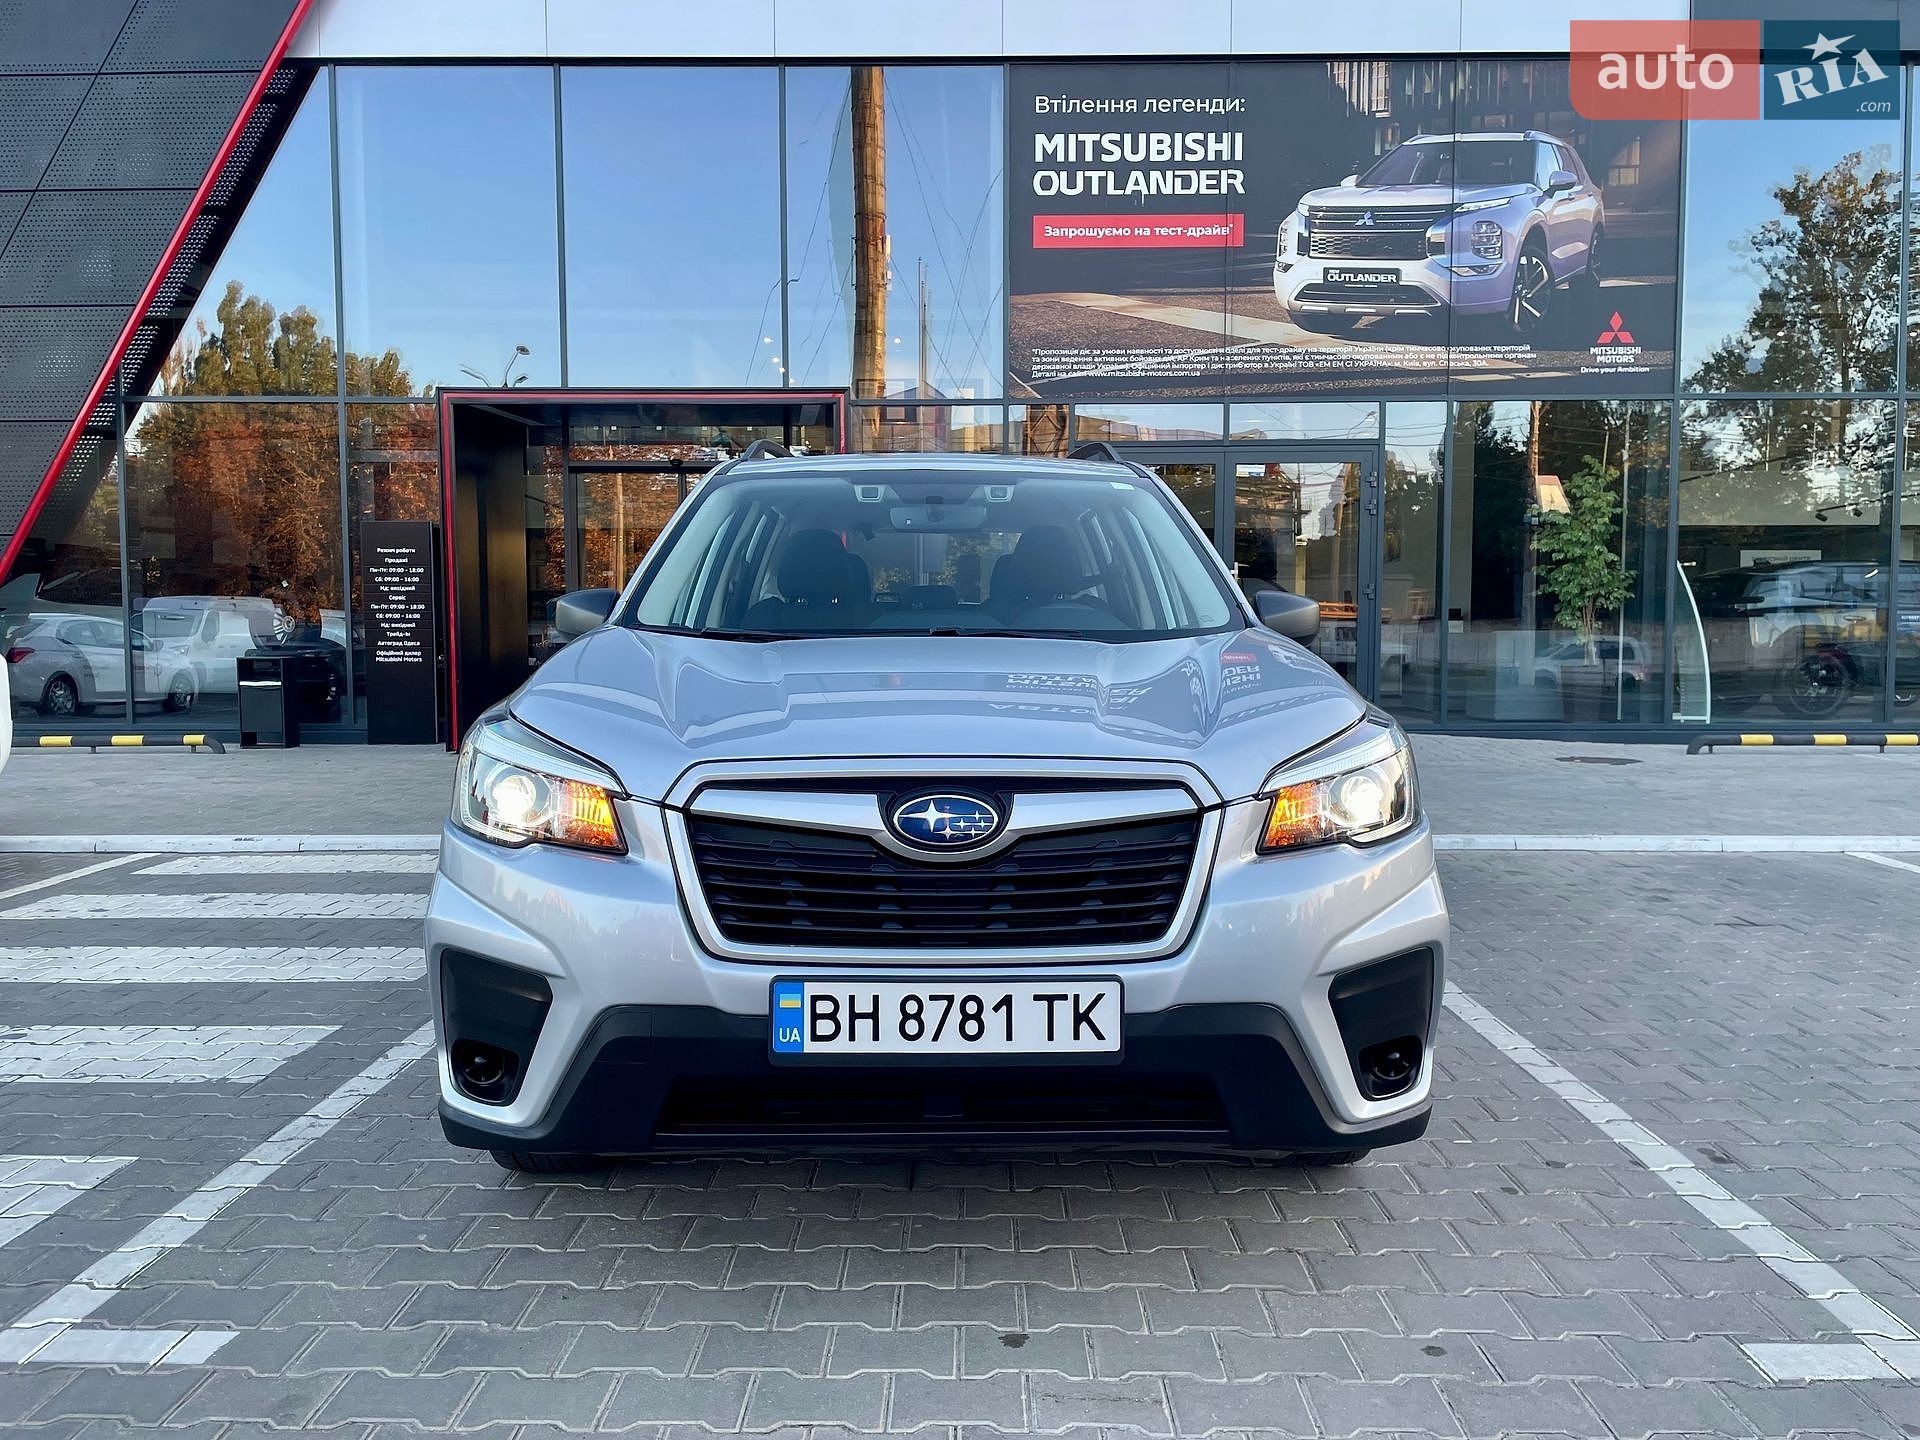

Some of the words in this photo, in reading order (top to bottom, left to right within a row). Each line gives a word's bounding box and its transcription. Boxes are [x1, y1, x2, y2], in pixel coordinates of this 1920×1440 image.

[1034, 94, 1138, 114] Втілення
[1143, 97, 1246, 115] легенди:
[1034, 131, 1243, 163] MITSUBISHI
[1032, 169, 1246, 196] OUTLANDER
[1044, 226, 1131, 239] Запрошуємо
[1134, 228, 1151, 237] на
[1327, 273, 1397, 282] OUTLANDER
[1590, 346, 1641, 355] MITSUBISHI
[1596, 355, 1635, 363] MOTORS
[1617, 365, 1650, 373] Ambition
[810, 994, 880, 1042] BH
[898, 994, 1013, 1042] 8781
[1032, 993, 1106, 1041] TK
[779, 1027, 800, 1042] UA
